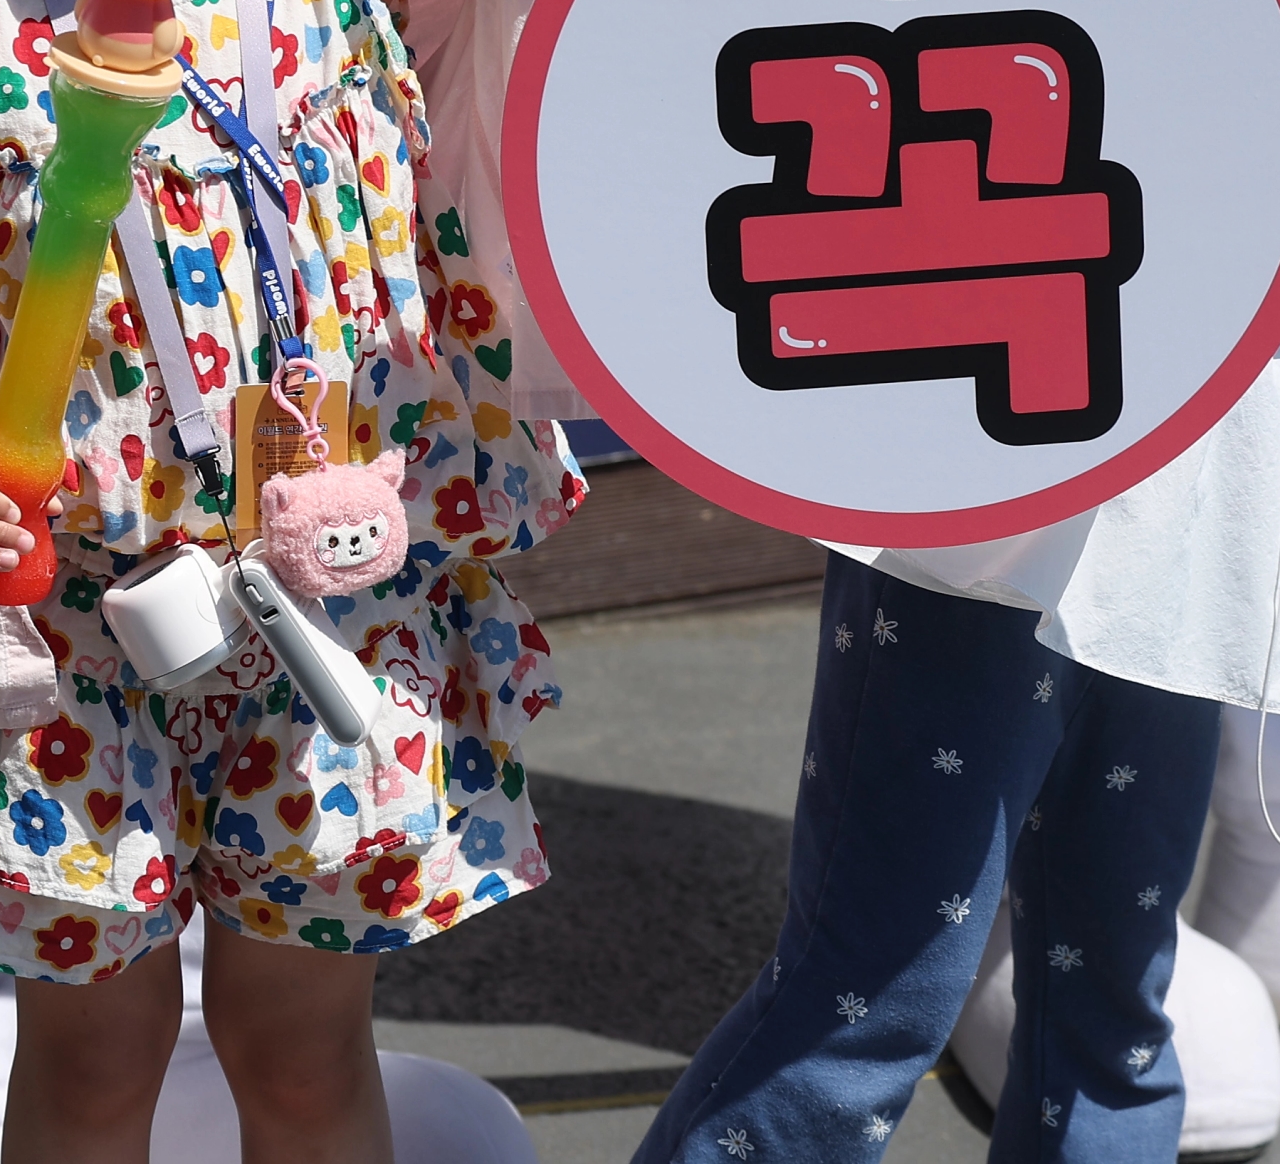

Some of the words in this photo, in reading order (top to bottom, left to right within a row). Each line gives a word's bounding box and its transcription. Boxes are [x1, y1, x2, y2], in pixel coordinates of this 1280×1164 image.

[183, 69, 226, 117] Eworld
[706, 10, 1144, 446] 꼭
[262, 269, 288, 320] world
